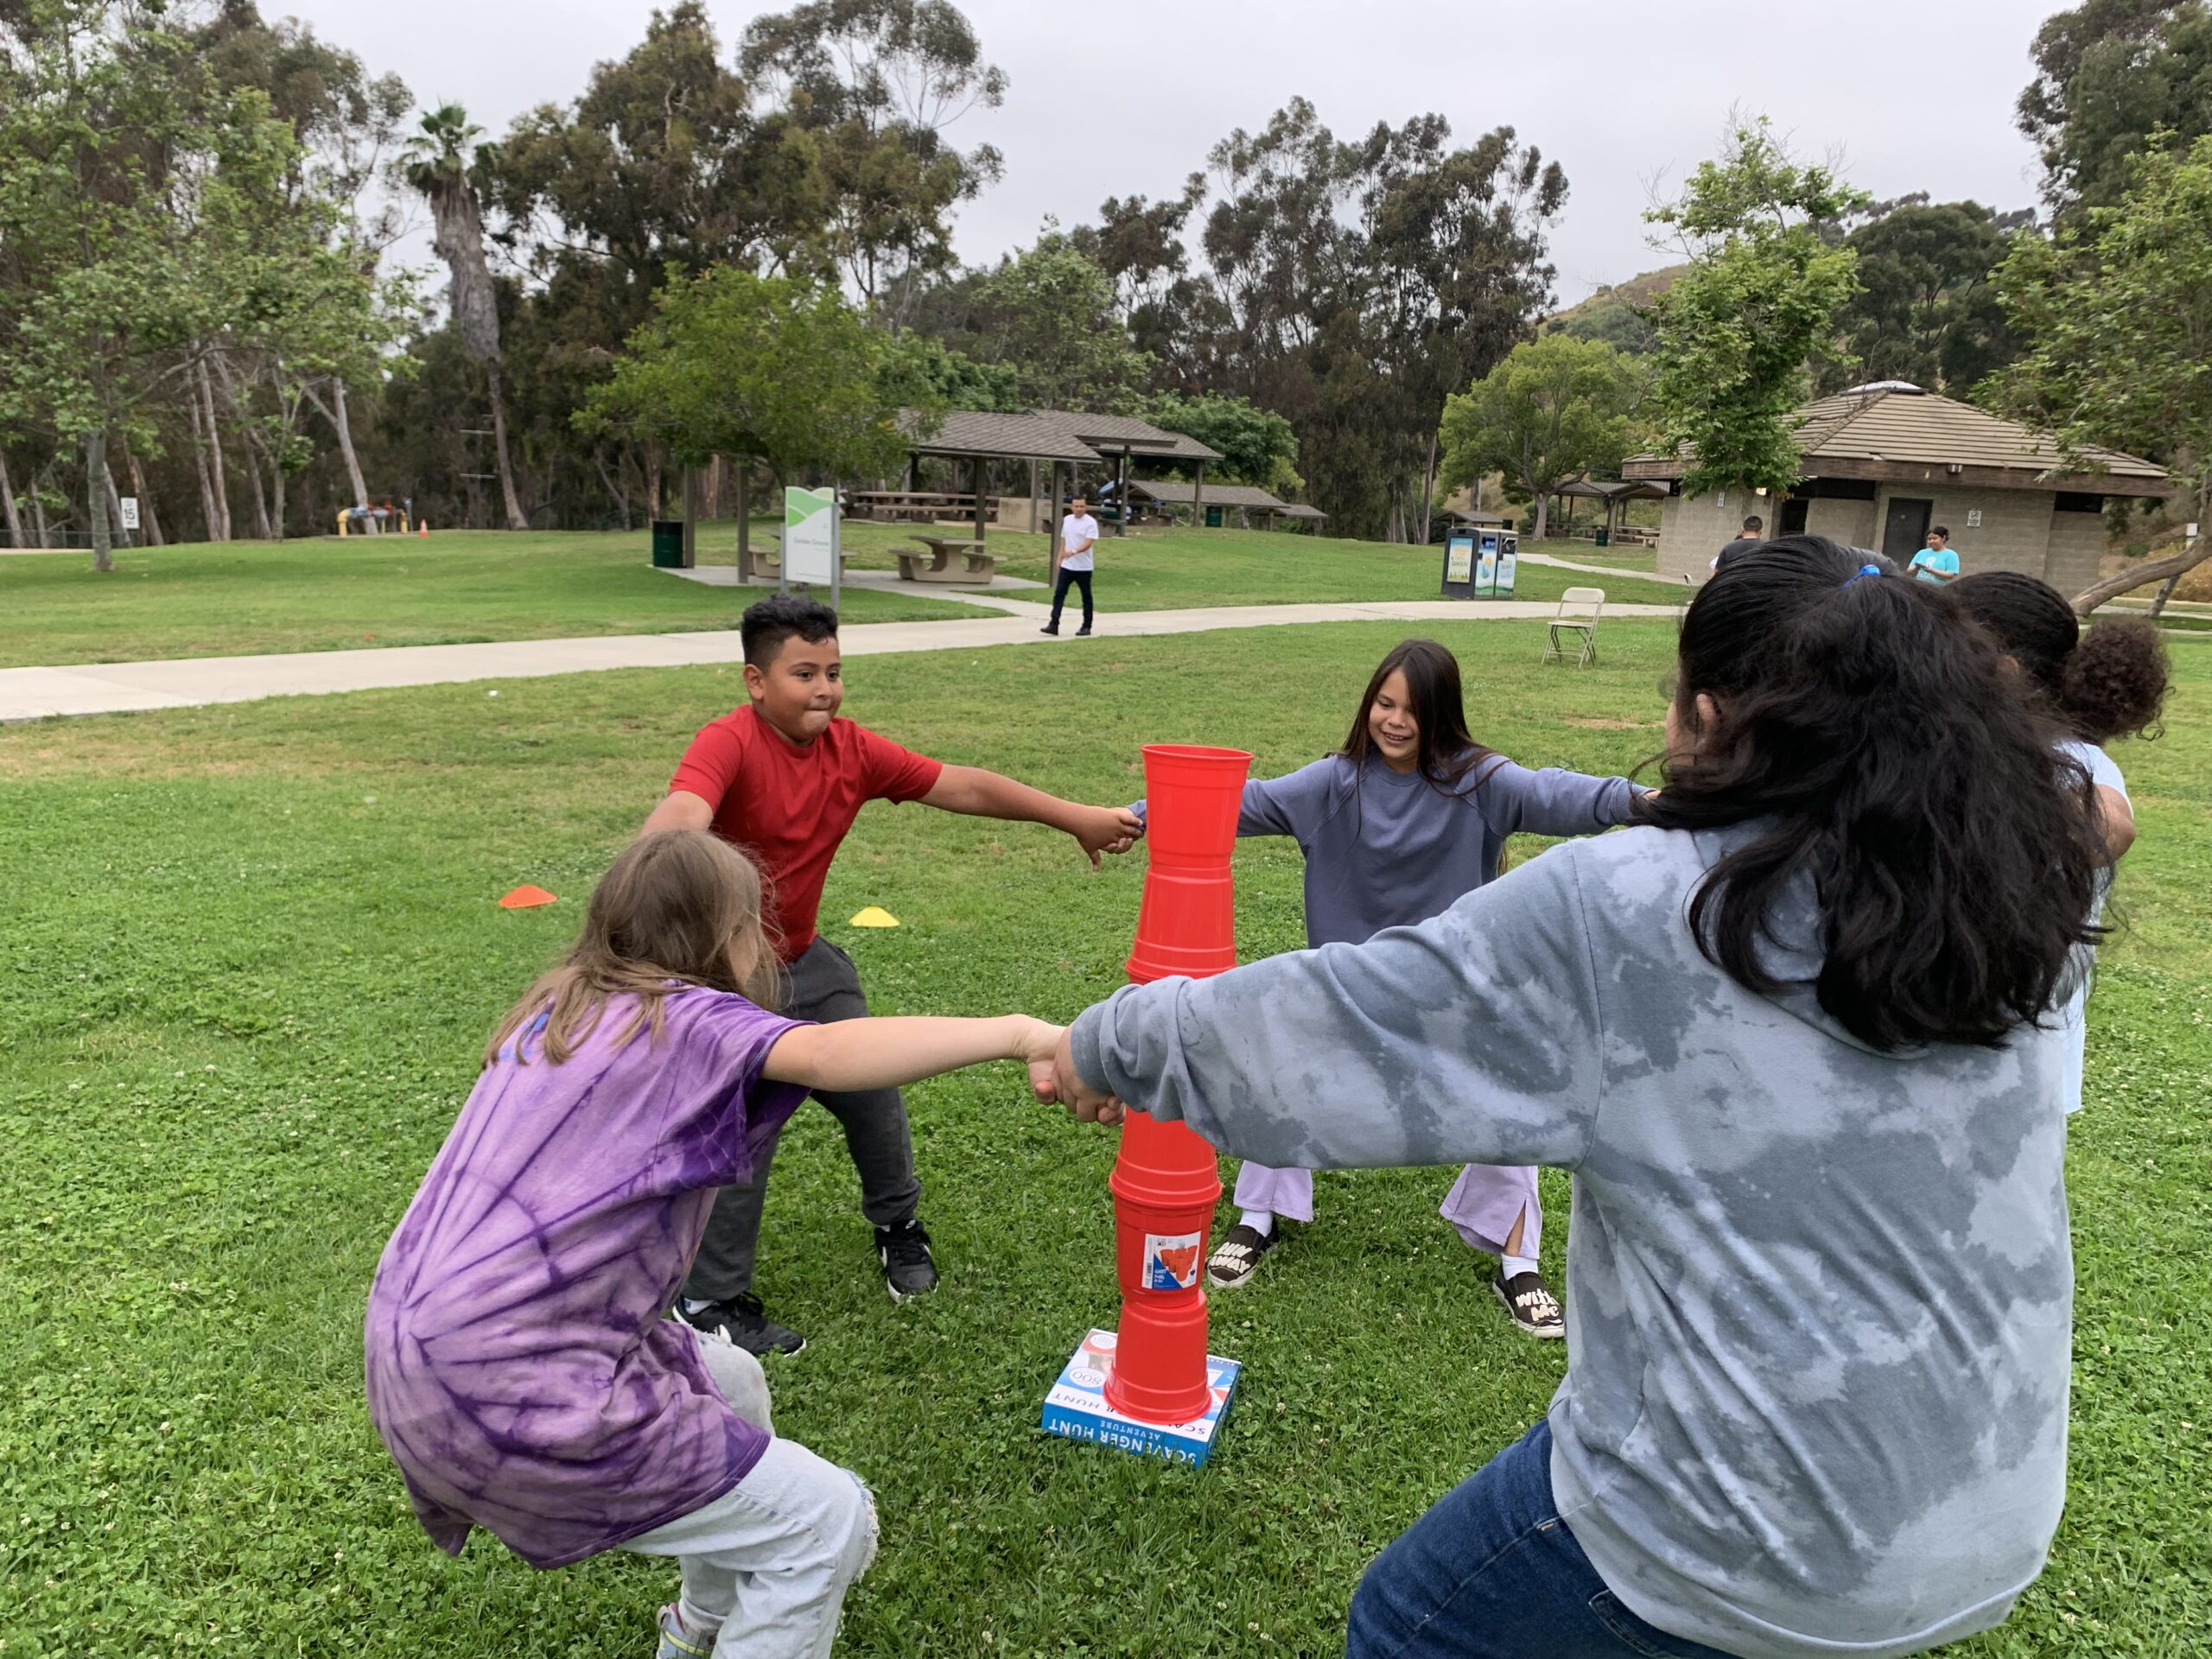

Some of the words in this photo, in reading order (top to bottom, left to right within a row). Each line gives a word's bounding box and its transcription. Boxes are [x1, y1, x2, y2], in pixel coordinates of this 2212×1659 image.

[1209, 1255, 1251, 1274] AWAY
[1071, 1370, 1102, 1386] 800
[1052, 1393, 1100, 1410] HUNT
[1048, 1418, 1094, 1440] HUNT
[1100, 1420, 1161, 1441] ADVENTURE
